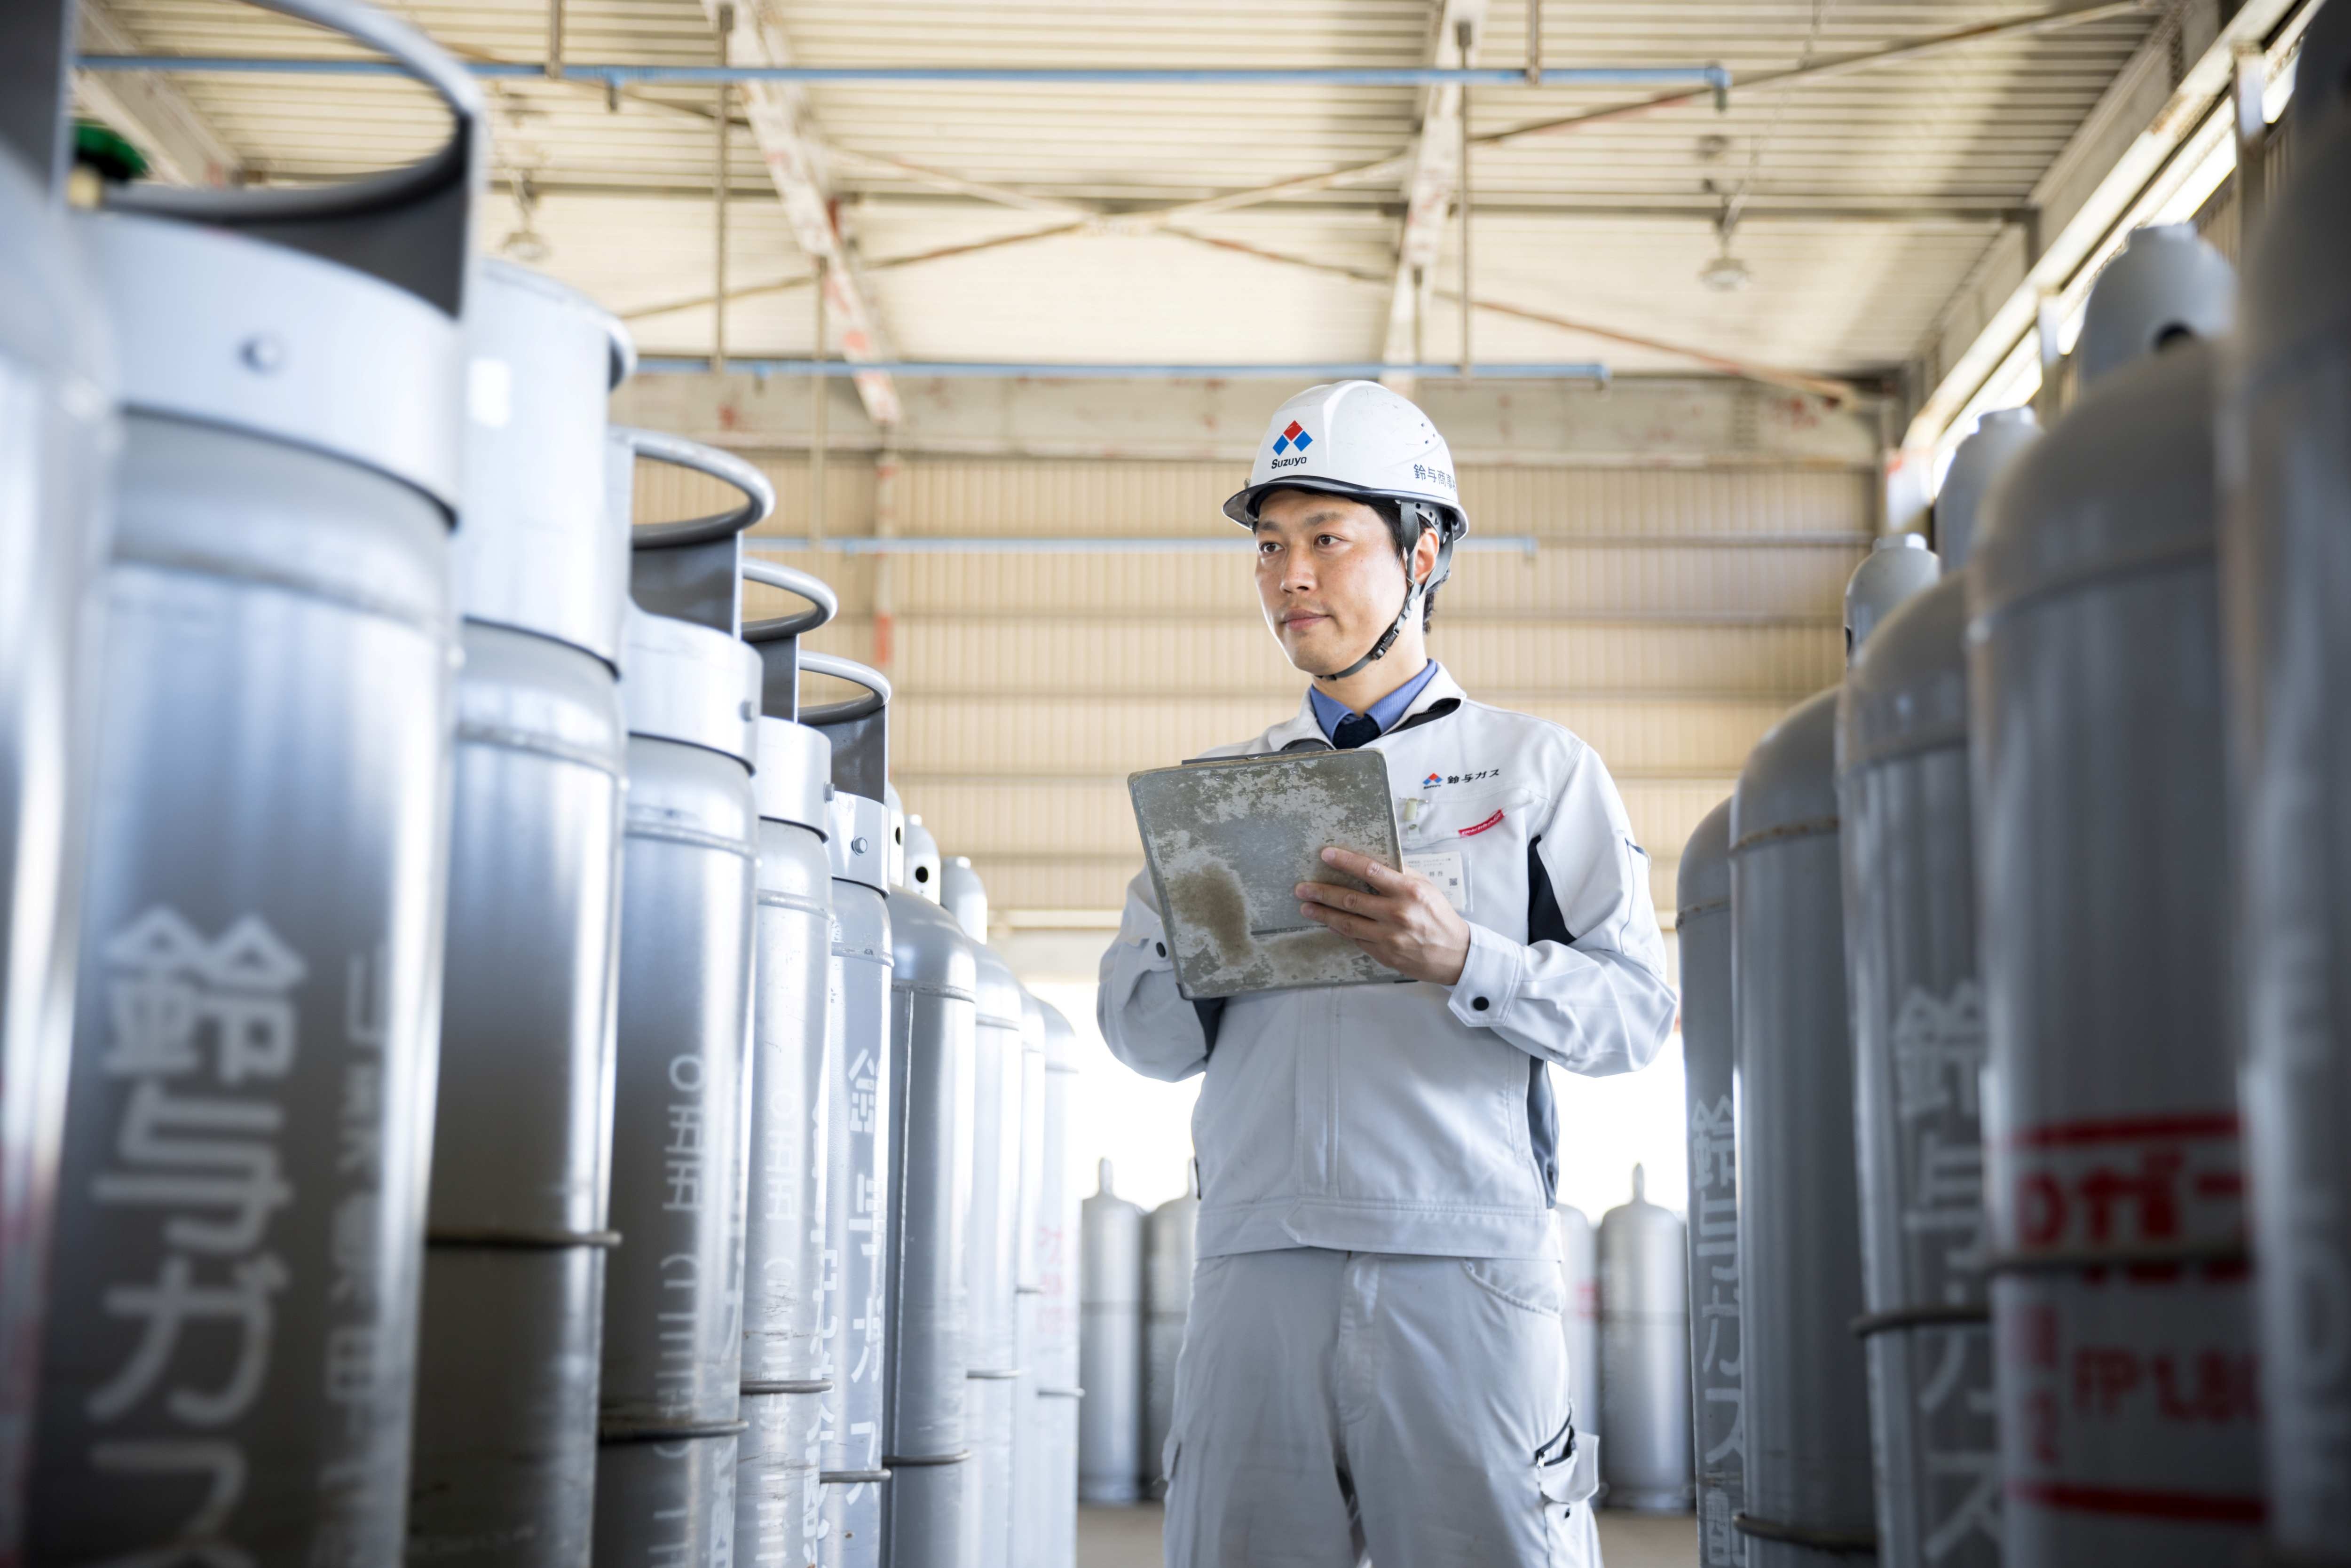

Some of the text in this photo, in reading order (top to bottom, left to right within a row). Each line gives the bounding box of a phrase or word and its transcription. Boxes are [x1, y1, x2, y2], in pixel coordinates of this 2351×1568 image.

[1271, 457, 1307, 469] Suzuyo
[1413, 464, 1456, 491] 鈴与商事
[1447, 769, 1499, 784] 鈴与ガス
[87, 905, 310, 1568] 鈴与ガス
